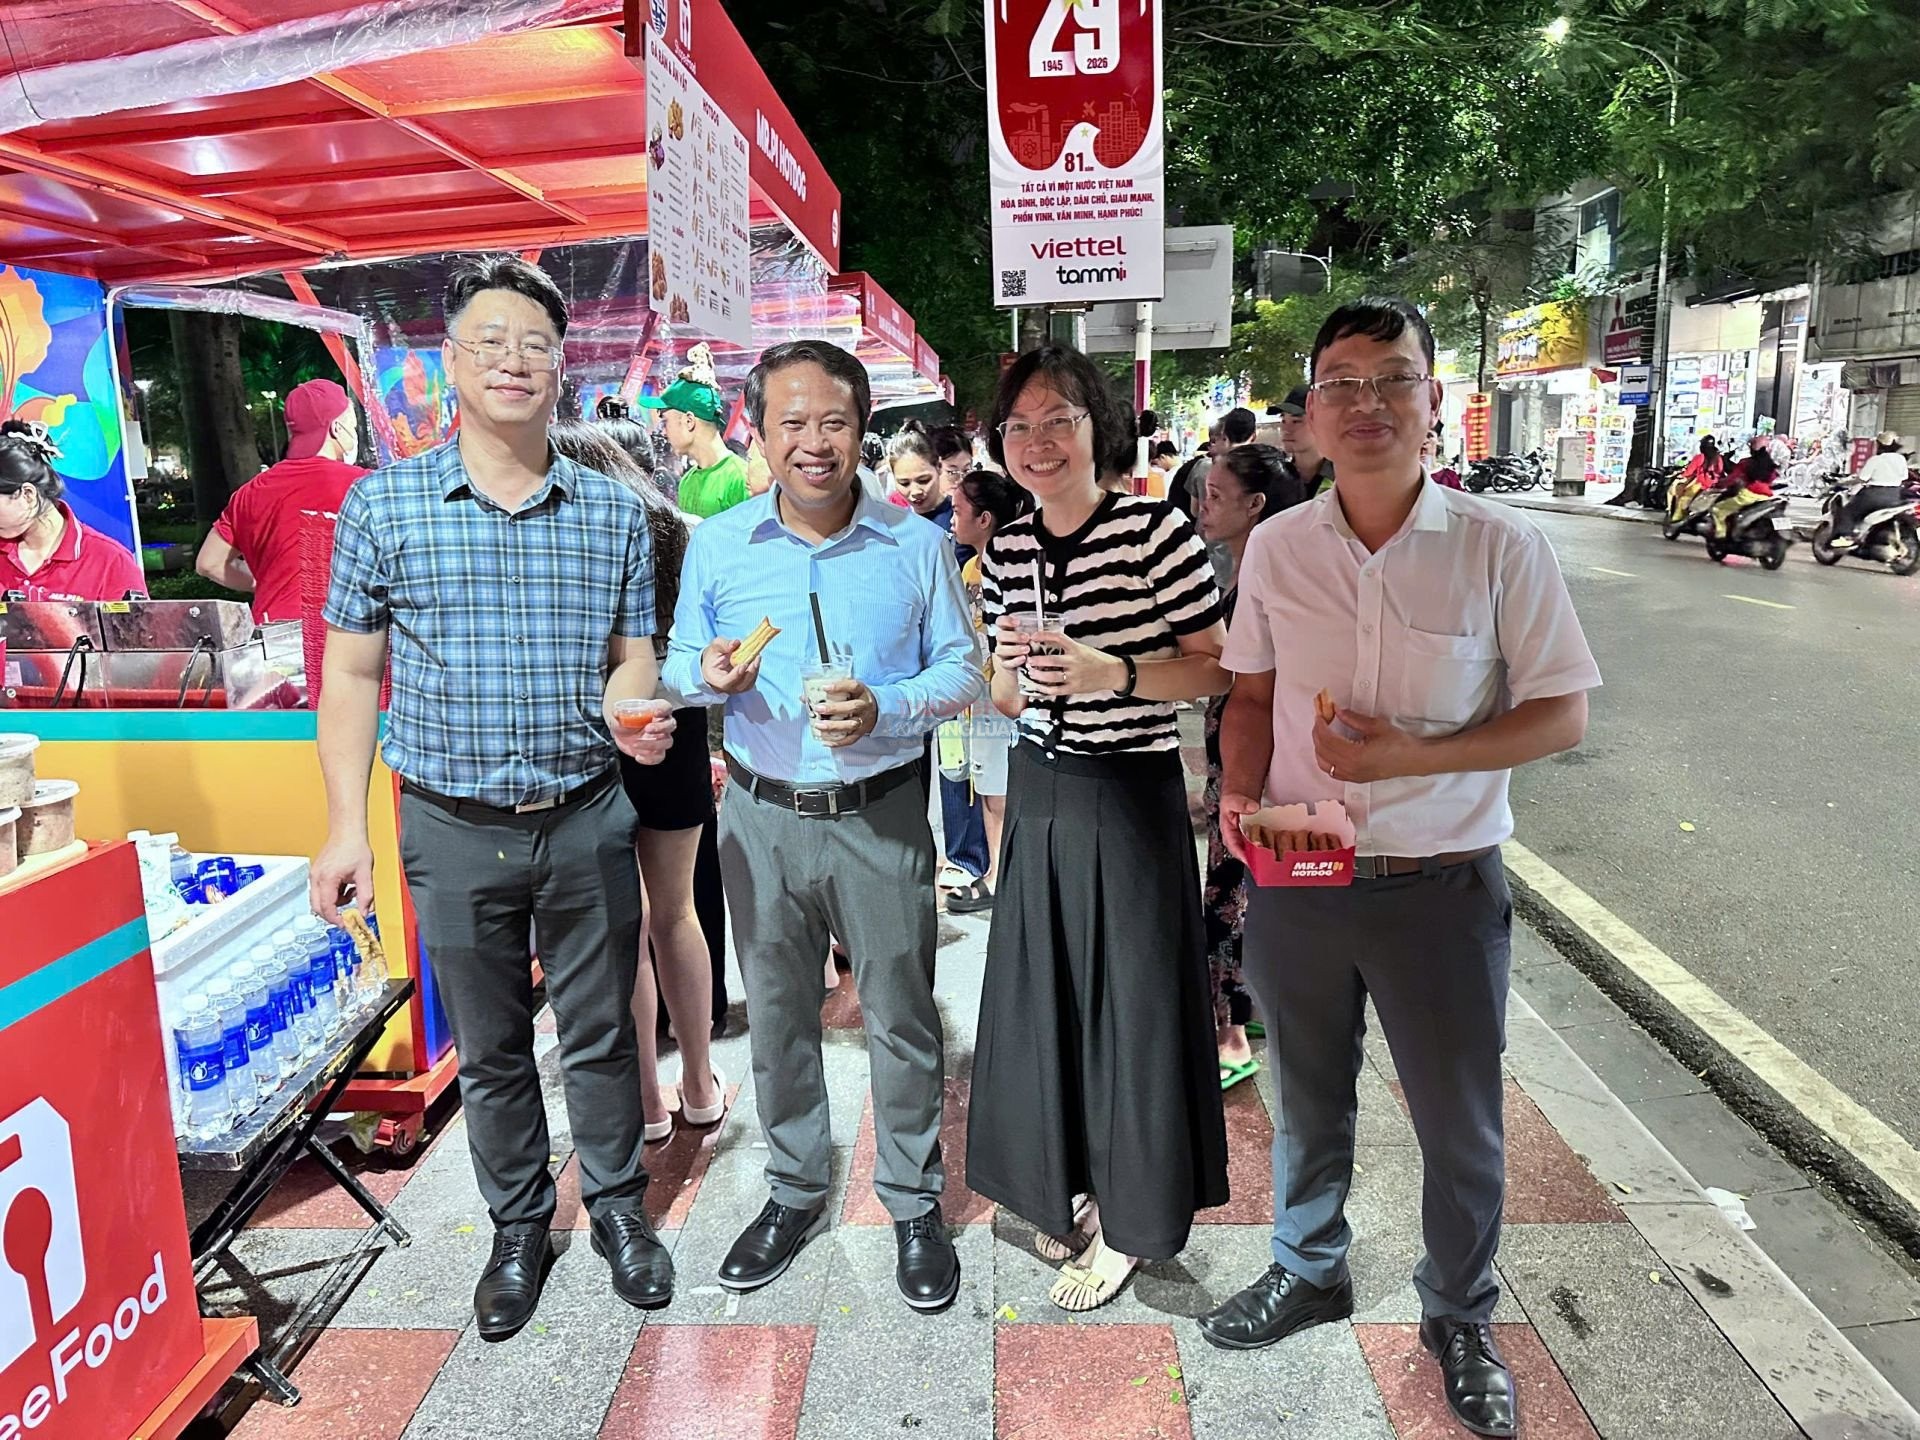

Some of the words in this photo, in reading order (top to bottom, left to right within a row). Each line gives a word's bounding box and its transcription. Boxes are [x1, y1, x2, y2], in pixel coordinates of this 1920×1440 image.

[1042, 60, 1063, 71] 1945
[1086, 57, 1108, 70] 2026
[1064, 152, 1084, 173] 81
[779, 139, 807, 203] HOTDOG
[1021, 181, 1034, 193] TẤT
[1036, 180, 1047, 193] CẢ
[1058, 180, 1073, 193] MỘT
[1075, 179, 1096, 190] NƯỚC
[1098, 178, 1114, 191] VIỆT
[1115, 179, 1133, 188] NAM
[1000, 197, 1016, 208] HÒA
[1039, 196, 1055, 208] ĐỘC
[1073, 194, 1089, 205] DÂN
[1098, 209, 1118, 221] HẠNH
[1031, 235, 1127, 260] viettel
[1294, 862, 1333, 870] MR.PI
